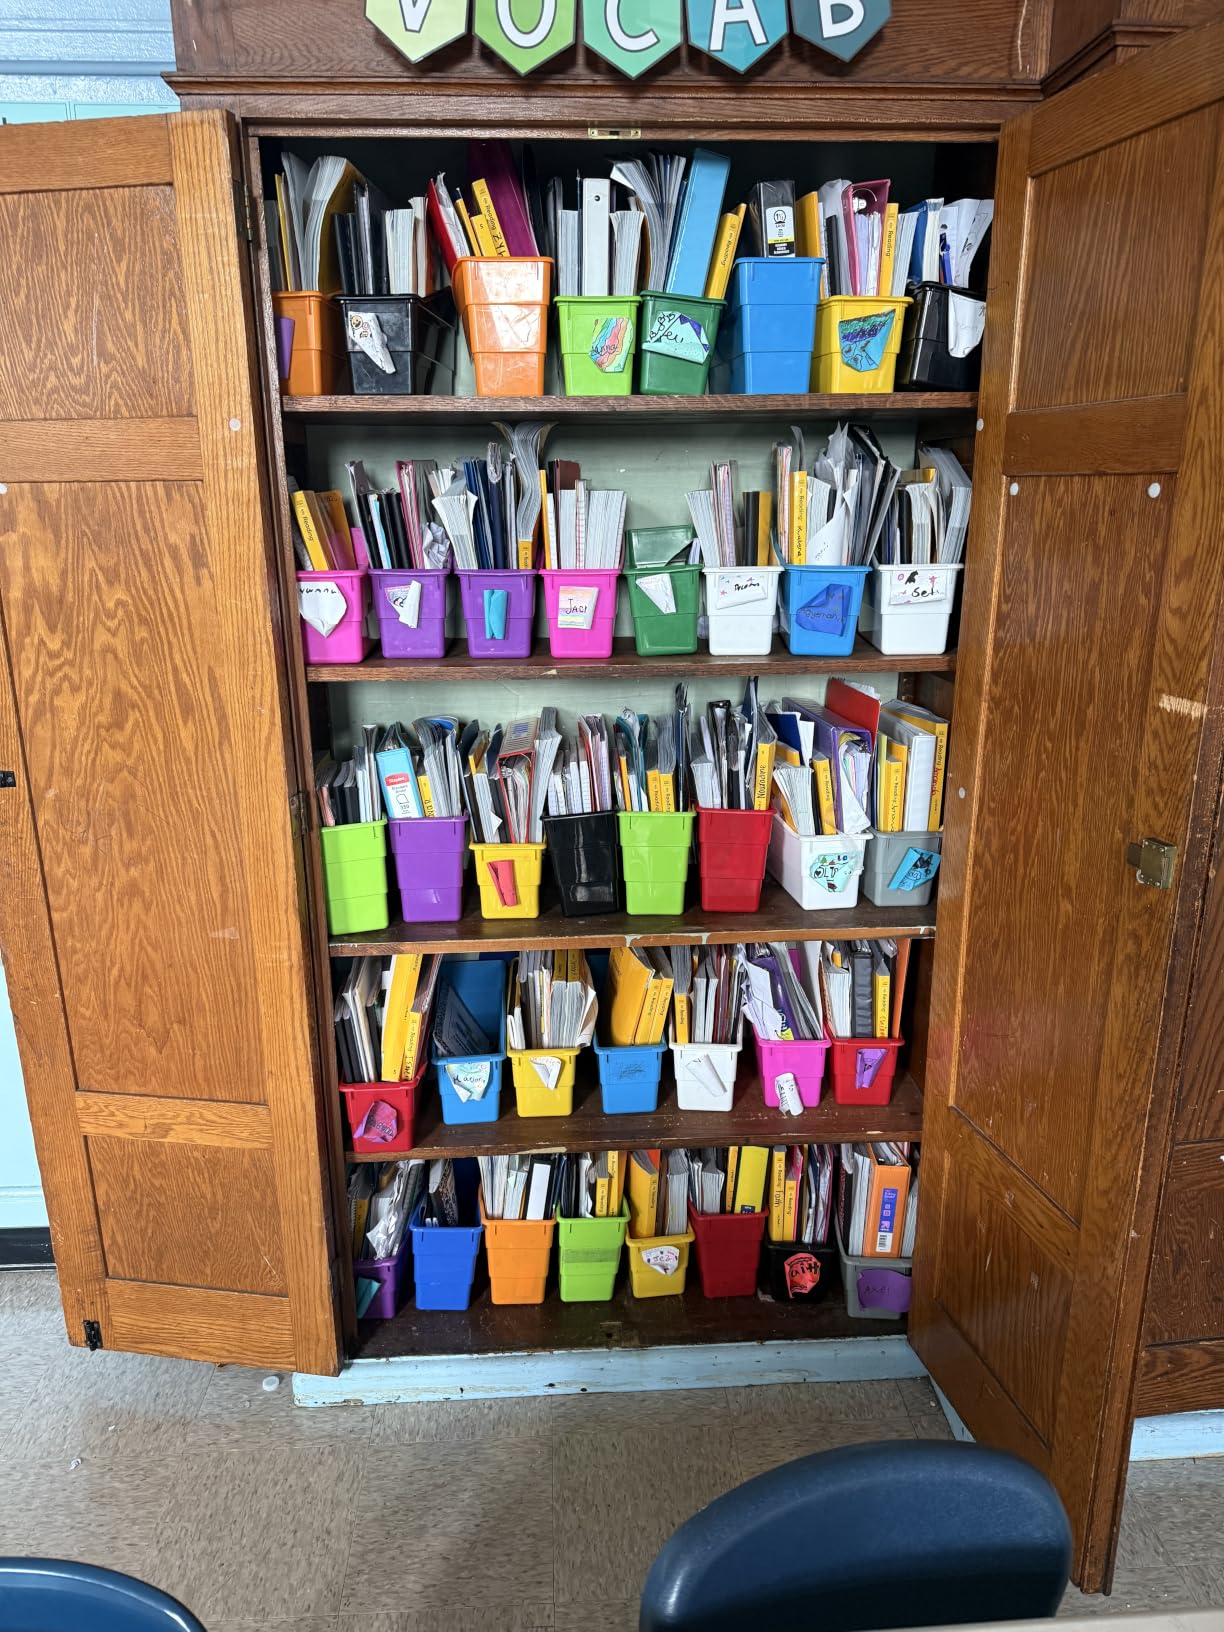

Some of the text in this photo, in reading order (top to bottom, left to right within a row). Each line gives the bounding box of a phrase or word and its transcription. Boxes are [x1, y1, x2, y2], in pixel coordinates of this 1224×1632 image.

[398, 0, 866, 52] VOCAB
[885, 230, 894, 257] Reading
[303, 516, 314, 542] Reading
